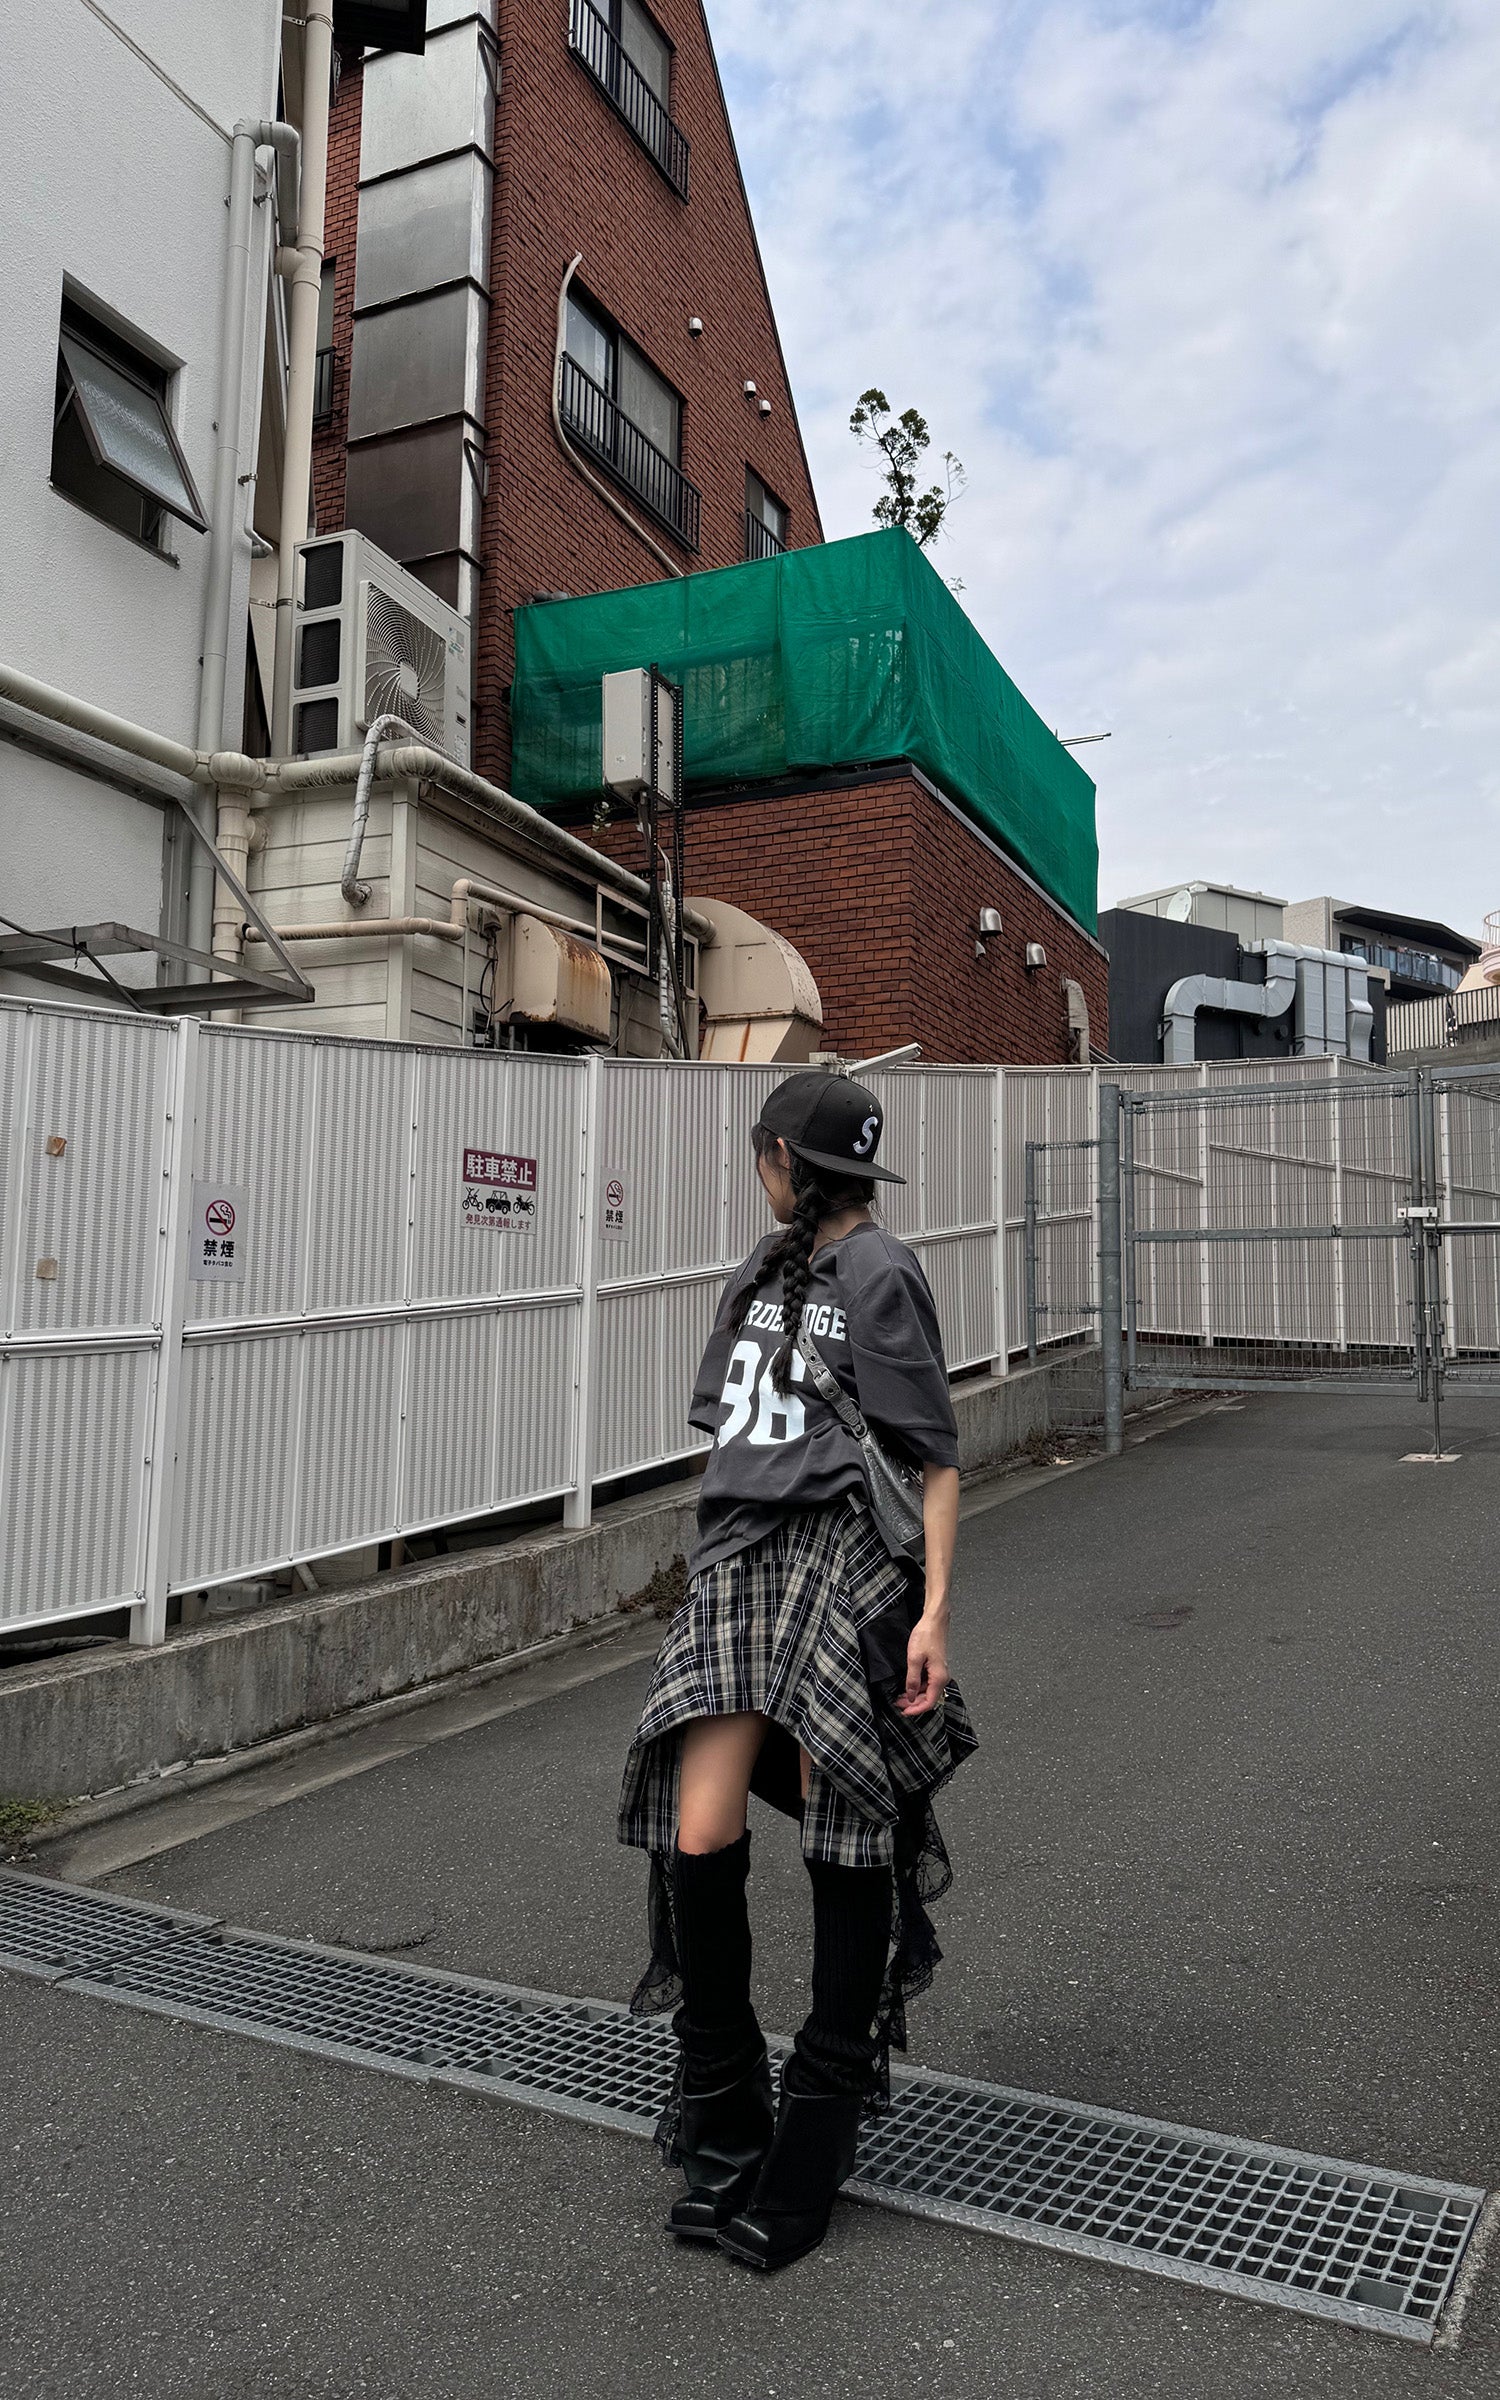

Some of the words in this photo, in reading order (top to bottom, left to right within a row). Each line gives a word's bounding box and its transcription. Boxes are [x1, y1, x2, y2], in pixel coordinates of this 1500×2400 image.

[853, 1116, 879, 1155] S
[466, 1153, 533, 1186] 駐車禁止
[465, 1213, 532, 1231] 発見次第通報します
[605, 1209, 624, 1223] 禁煙
[203, 1239, 235, 1258] 禁煙
